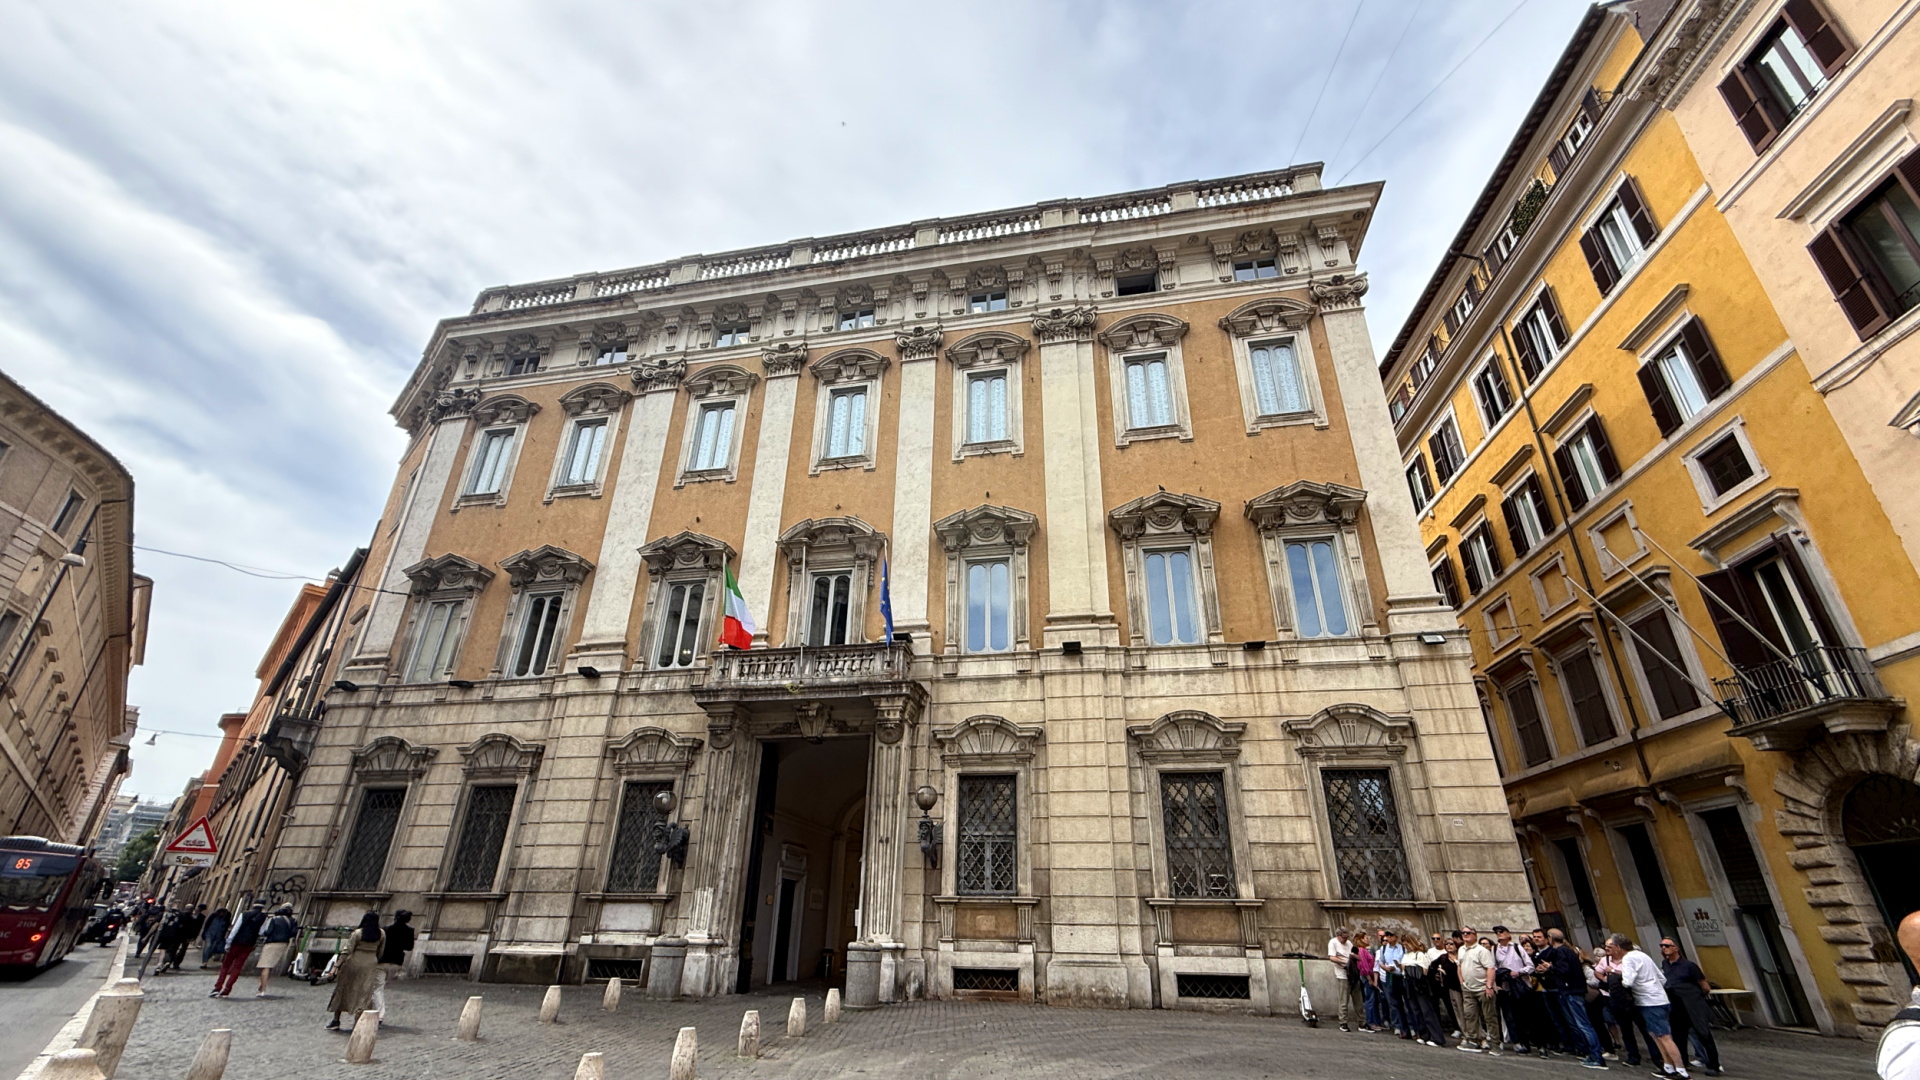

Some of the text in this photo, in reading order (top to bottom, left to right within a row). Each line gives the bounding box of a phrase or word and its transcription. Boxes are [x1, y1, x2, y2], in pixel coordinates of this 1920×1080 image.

[15, 858, 33, 869] 85
[16, 920, 37, 928] 2104
[1692, 921, 1719, 931] GRANO
